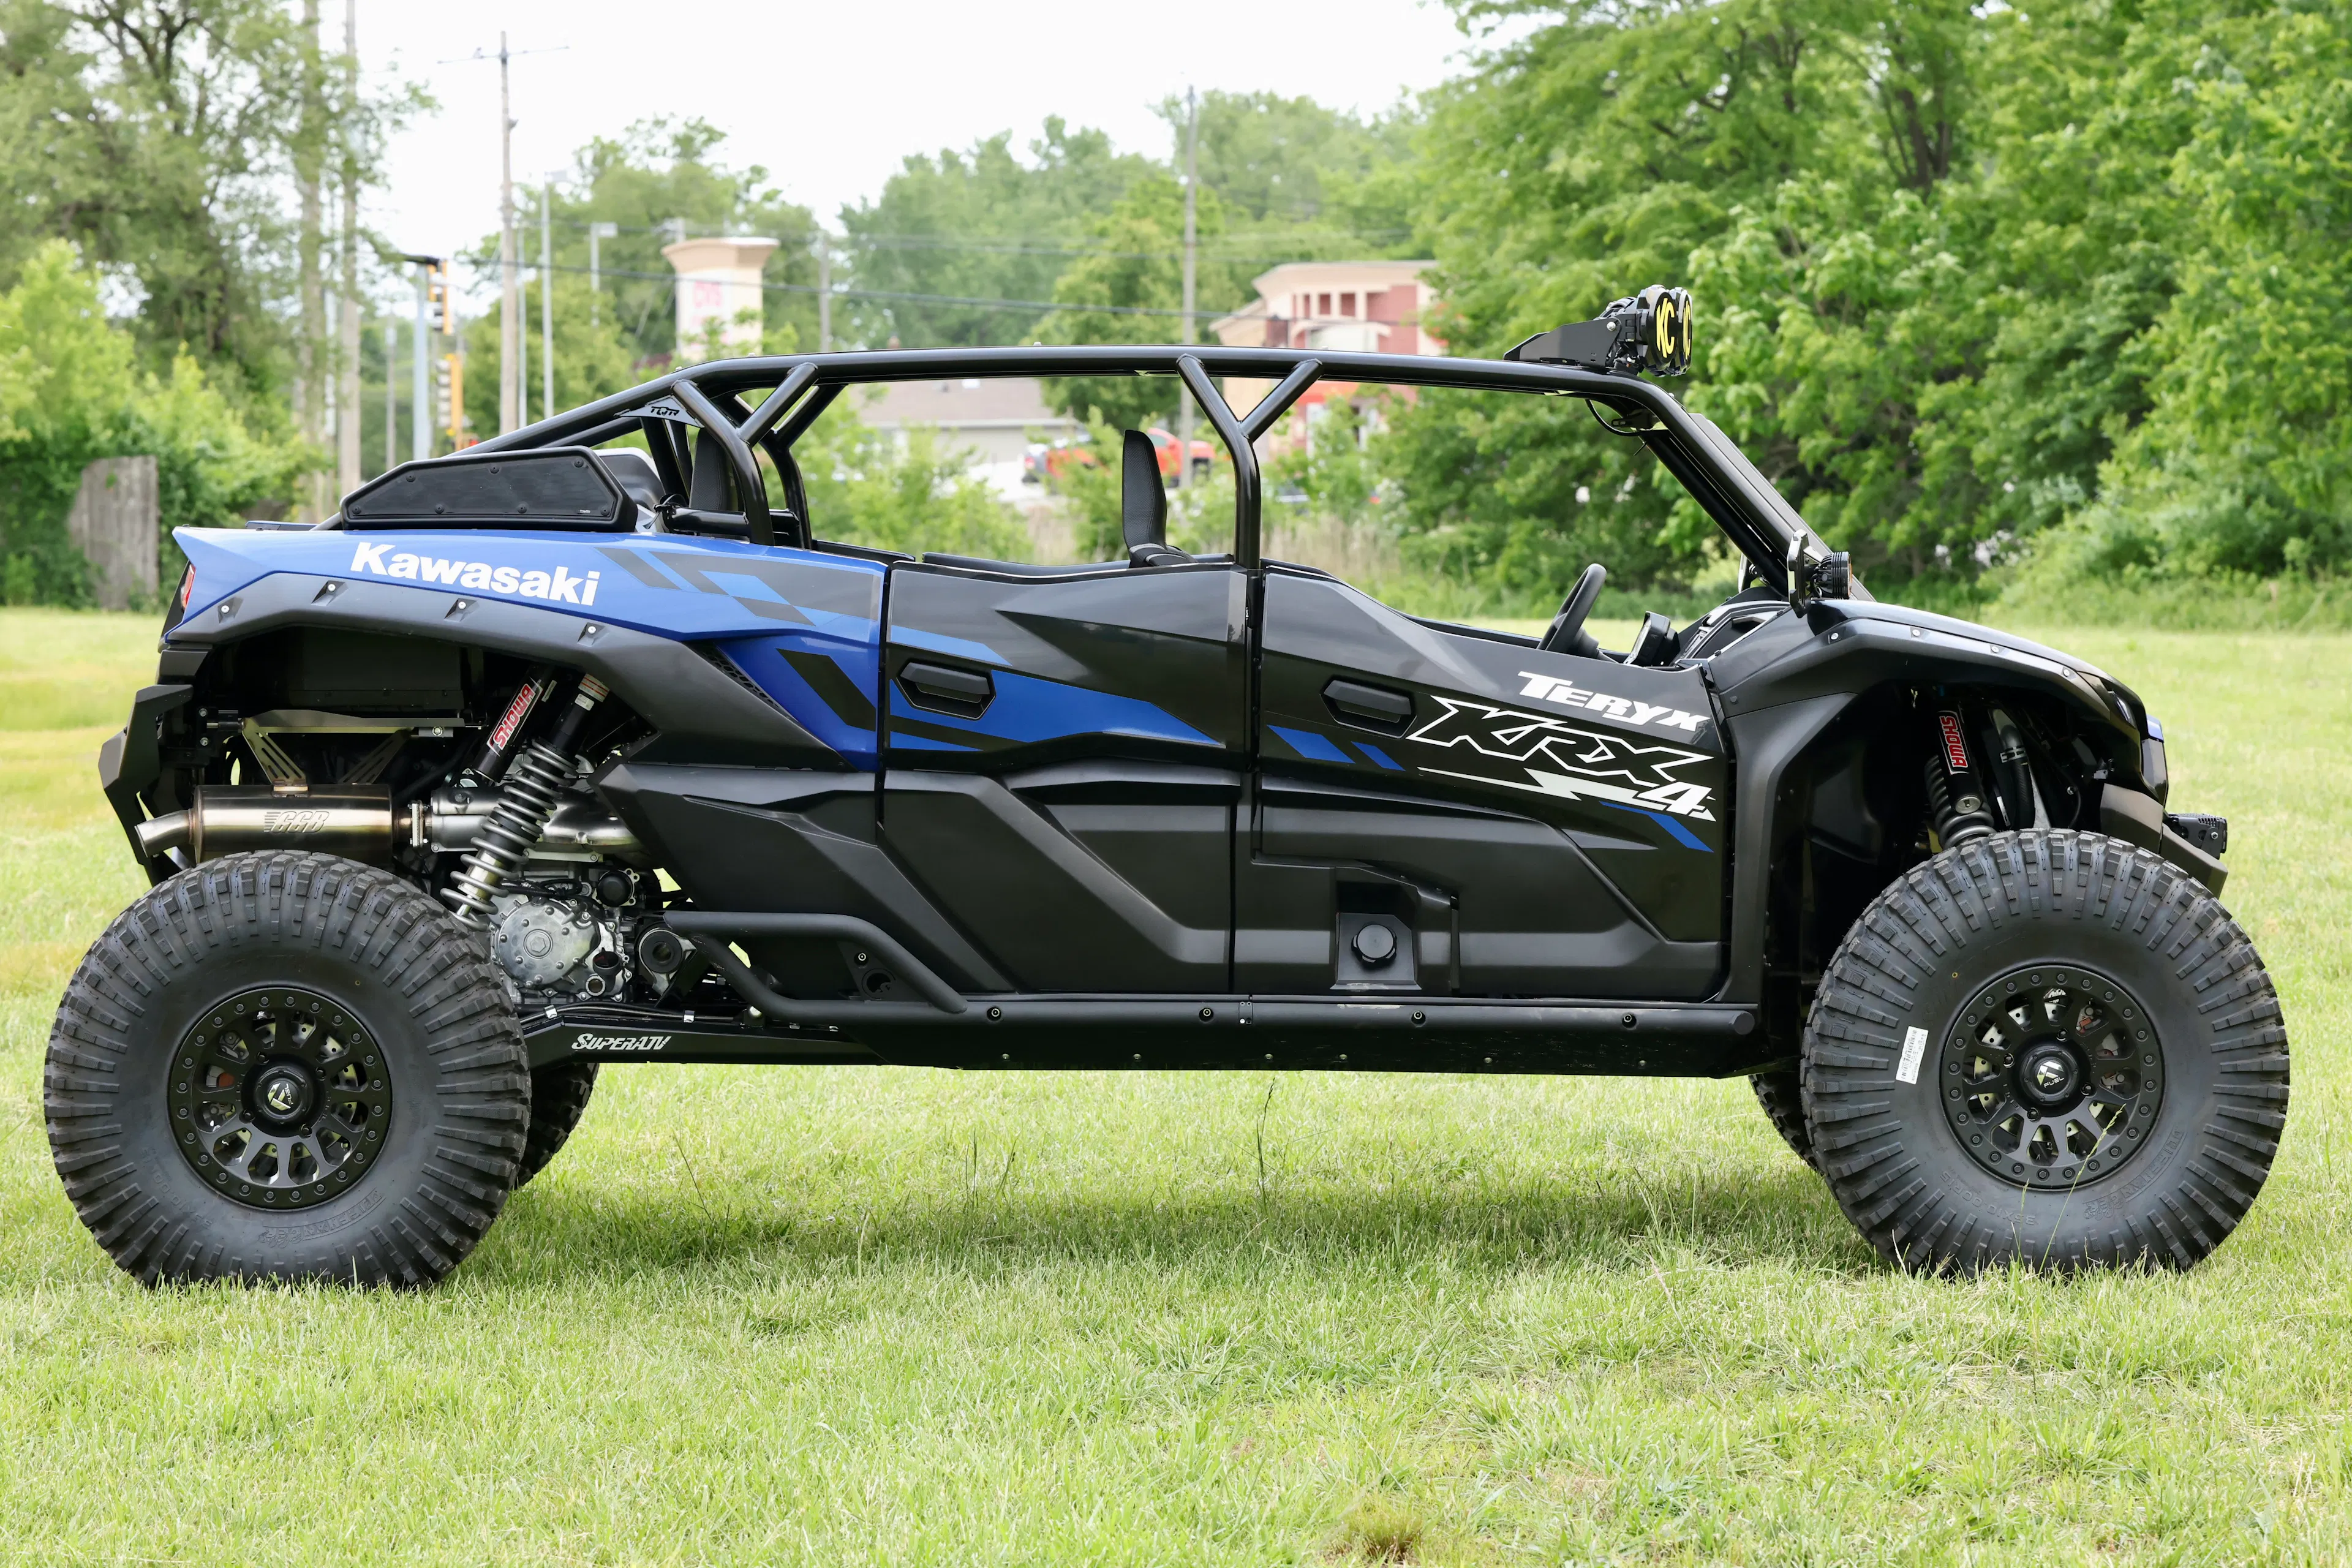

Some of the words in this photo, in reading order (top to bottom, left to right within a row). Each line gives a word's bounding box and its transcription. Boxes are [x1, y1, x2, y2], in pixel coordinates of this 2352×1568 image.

[1656, 298, 1675, 358] KC
[350, 541, 600, 606] Kawasaki
[493, 684, 536, 750] SHOWA
[1517, 671, 1710, 732] TERYX
[1406, 695, 1714, 788] KRX
[1637, 782, 1712, 815] 4
[1939, 716, 1968, 767] SHOWA
[284, 1083, 294, 1106] FUEL
[2043, 1076, 2065, 1088] FUEL
